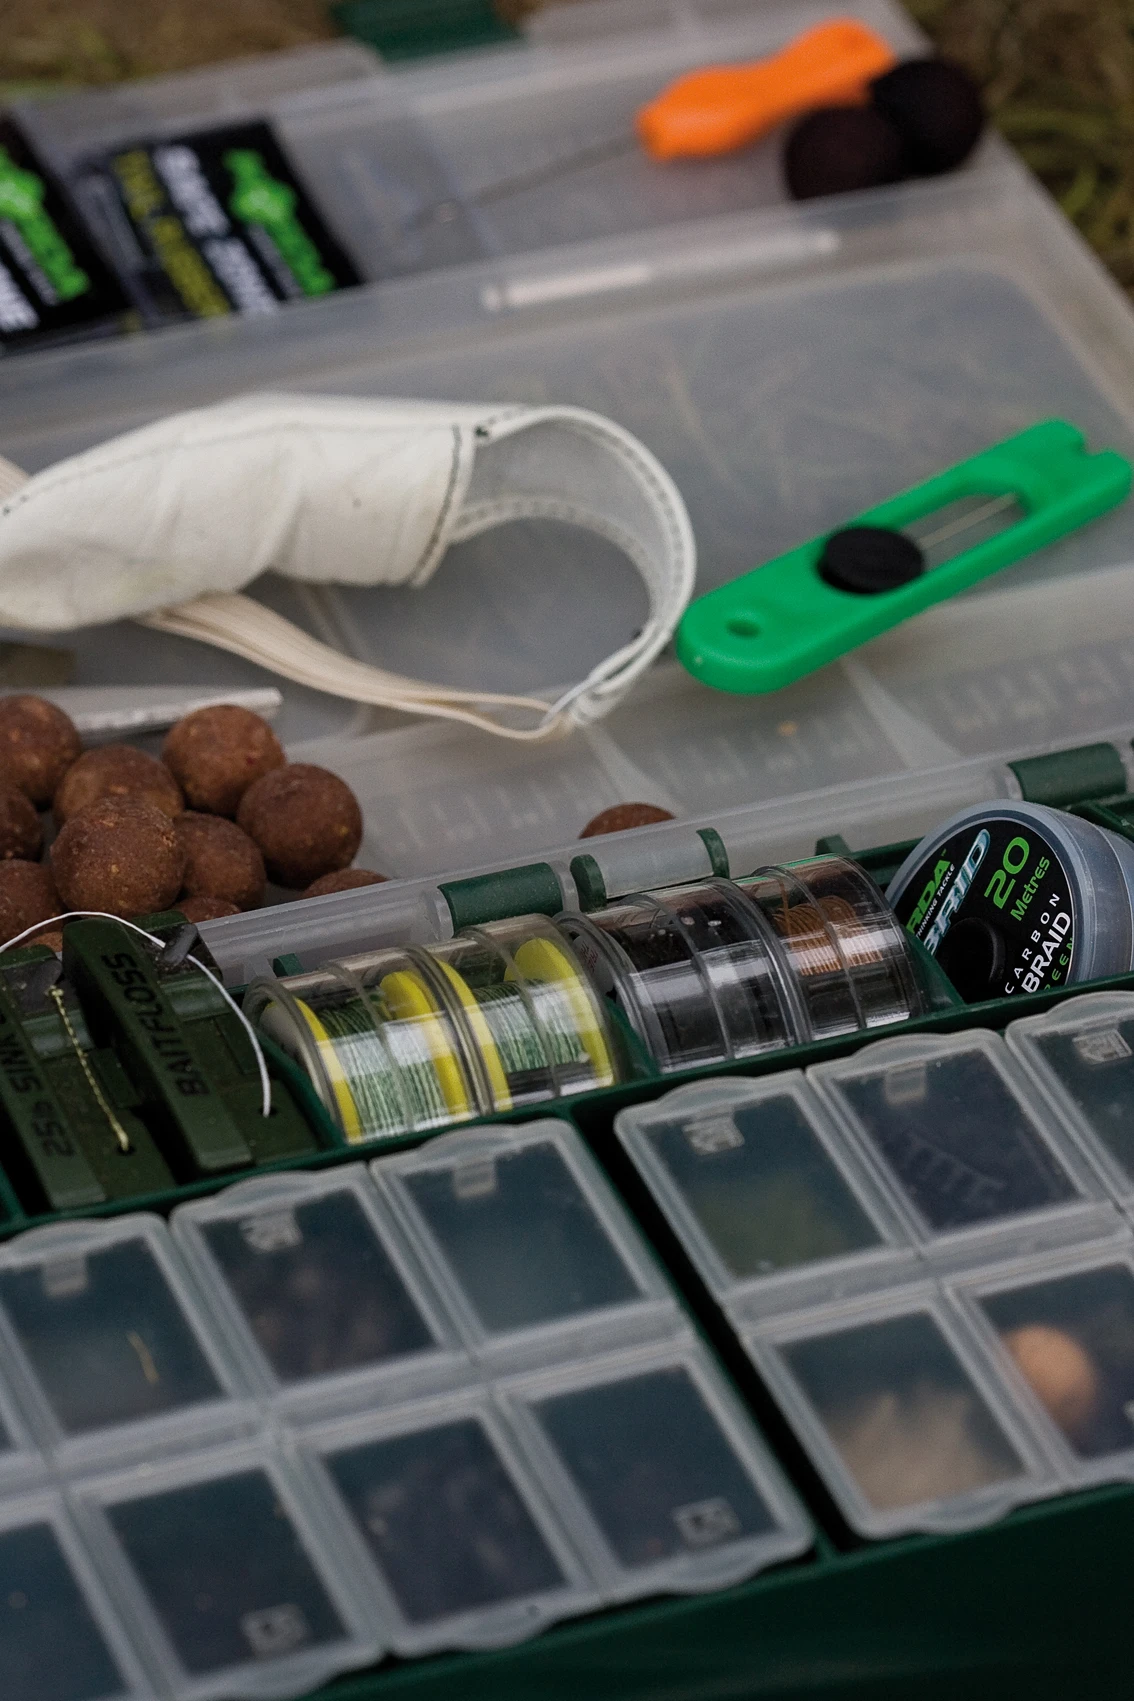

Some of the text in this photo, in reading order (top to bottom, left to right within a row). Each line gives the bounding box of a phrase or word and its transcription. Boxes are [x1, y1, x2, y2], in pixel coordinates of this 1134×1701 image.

[906, 860, 951, 934] RDA
[923, 829, 991, 956] BRID
[937, 863, 955, 898] TACKLE
[984, 837, 1030, 909] 20
[1010, 856, 1050, 921] Metres
[1004, 893, 1060, 994] CARBON
[1021, 912, 1071, 994] BRAID
[101, 952, 210, 1096] BAITFLOSS
